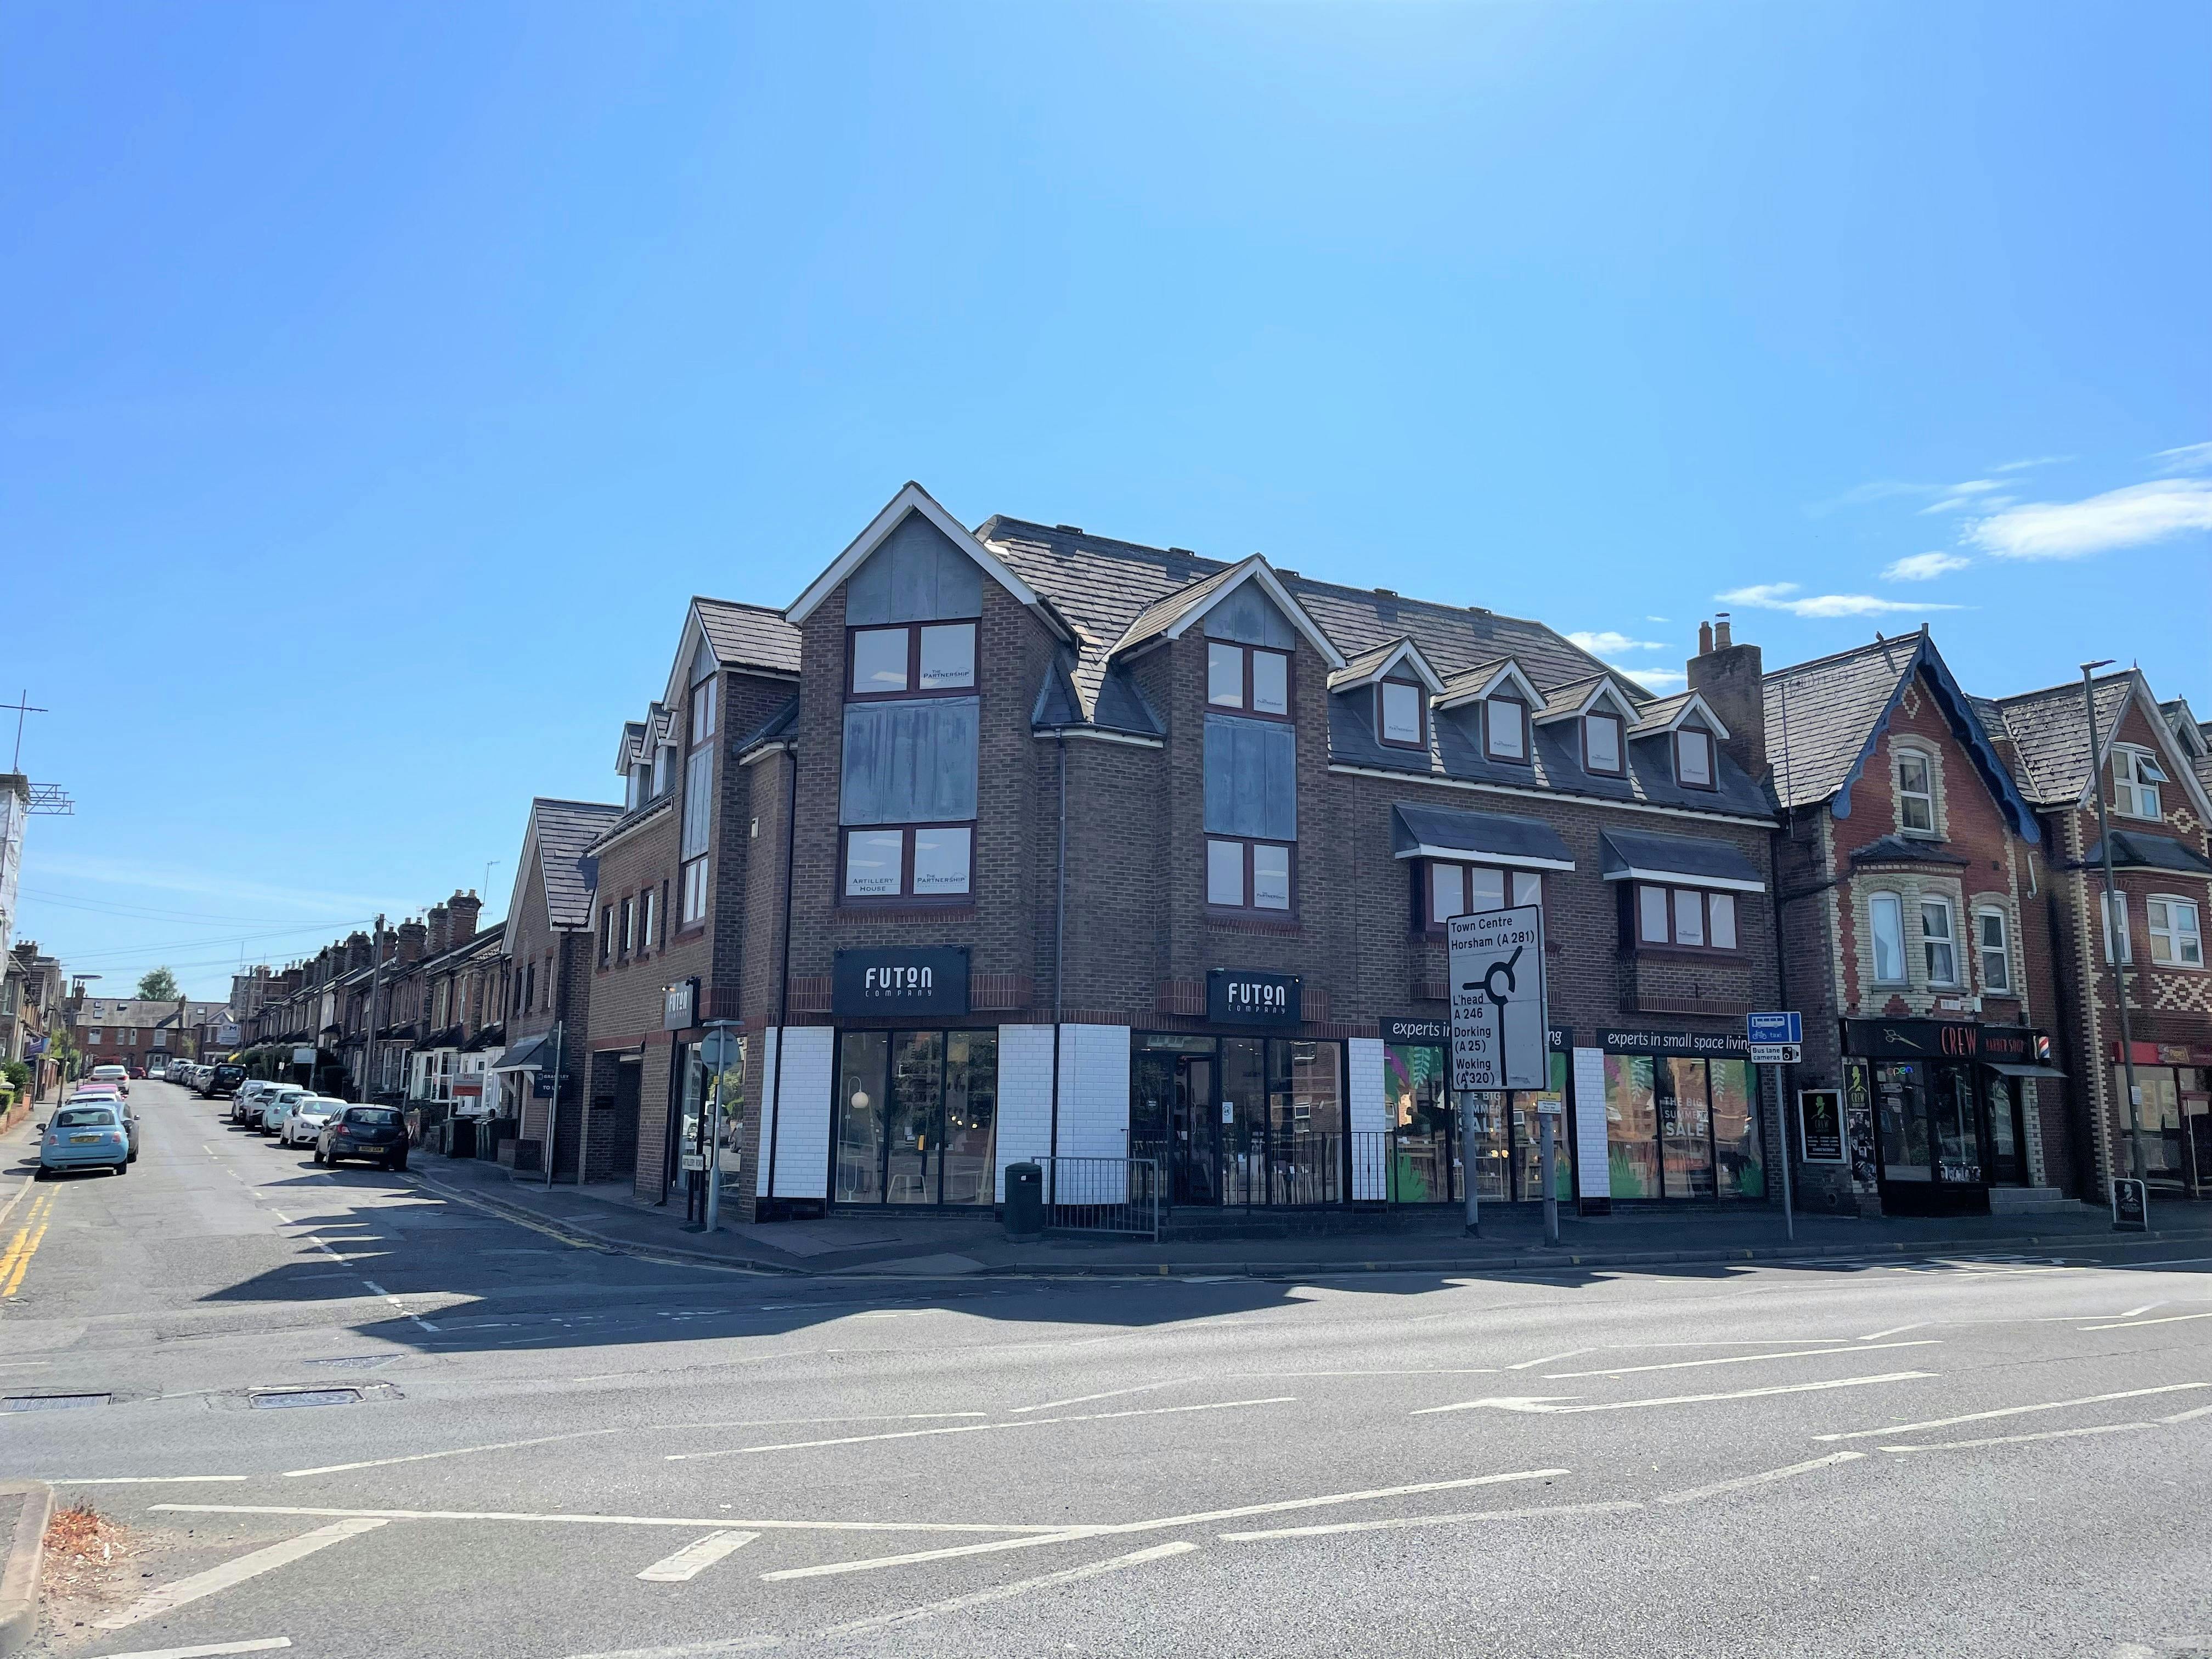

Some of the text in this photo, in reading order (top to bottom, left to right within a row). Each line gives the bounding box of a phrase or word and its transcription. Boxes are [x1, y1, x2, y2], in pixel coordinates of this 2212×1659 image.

[1451, 917, 1513, 933] Town Centre
[1452, 930, 1534, 950] Horsham (A 281)
[866, 967, 932, 989] FUTON
[1228, 983, 1285, 1006] FUTON
[1453, 993, 1483, 1006] L'head
[1454, 1008, 1483, 1020] A 246
[1392, 1022, 1440, 1039] experts
[1454, 1026, 1491, 1038] Dorking
[1455, 1040, 1486, 1054] (A 25)
[1607, 1032, 1649, 1048] experts
[1651, 1031, 1661, 1046] in
[1663, 1032, 1691, 1047] small
[1694, 1037, 1724, 1051] space
[1942, 1026, 1976, 1055] CREW
[1456, 1058, 1491, 1070] Woking
[1887, 1066, 1914, 1076] open
[1456, 1071, 1494, 1086] (A 320)
[1482, 1092, 1501, 1101] BIG
[1664, 1097, 1703, 1107] THE BIG
[1666, 1122, 1704, 1137] SALE
